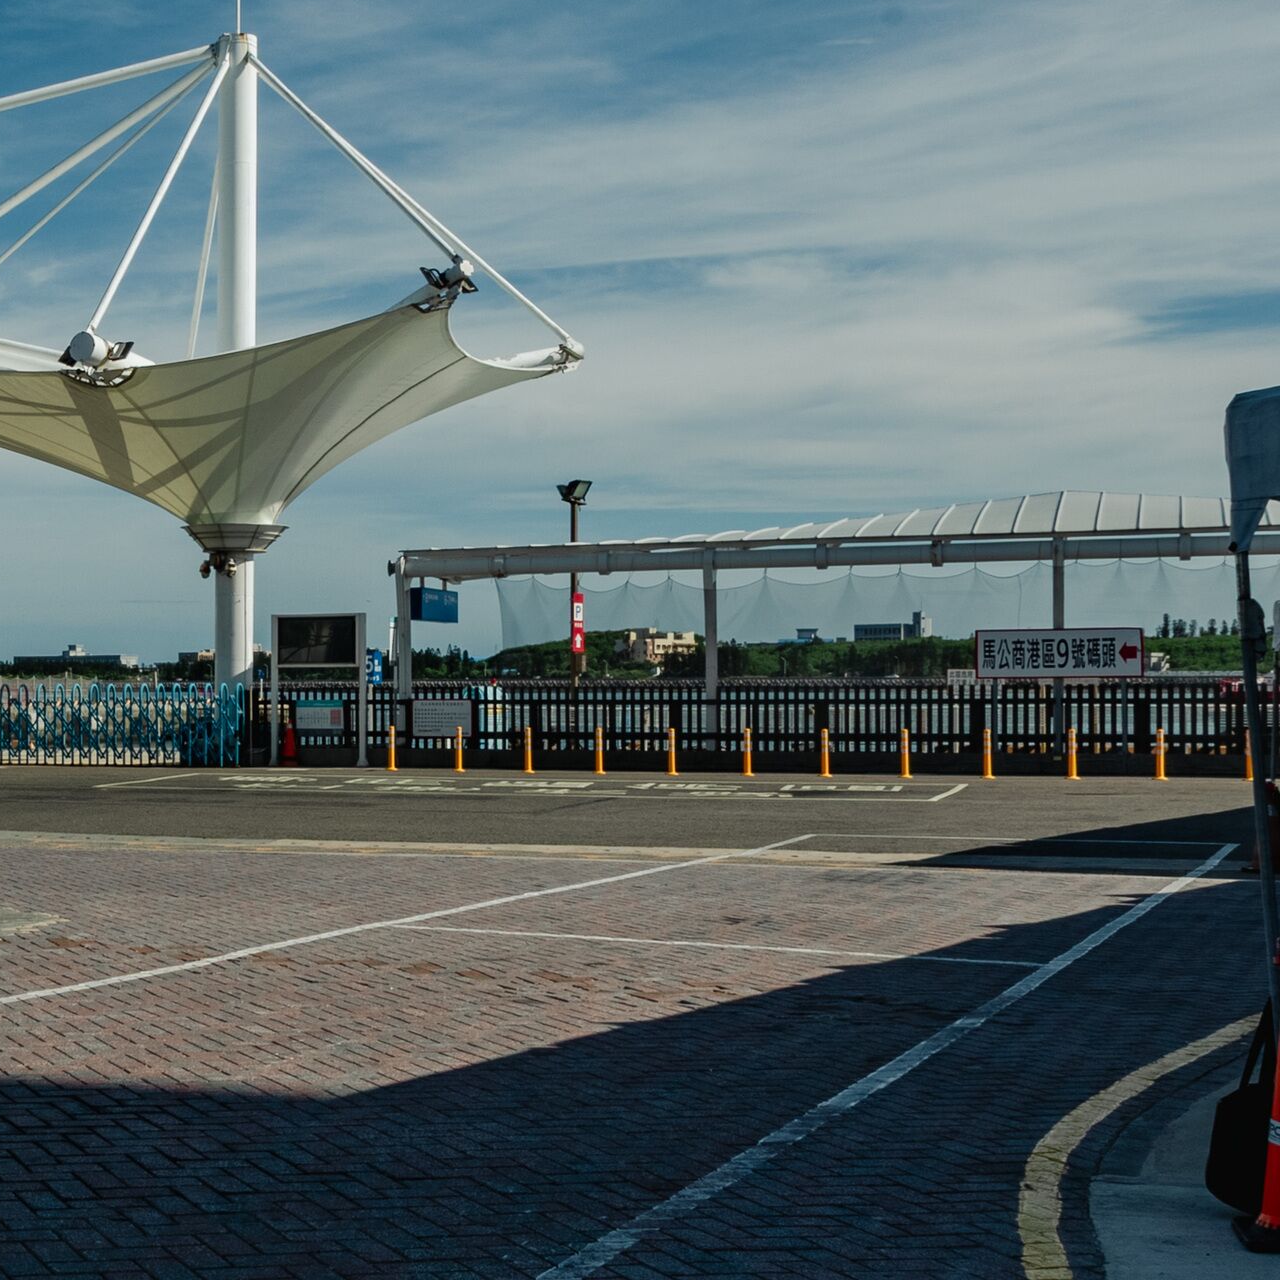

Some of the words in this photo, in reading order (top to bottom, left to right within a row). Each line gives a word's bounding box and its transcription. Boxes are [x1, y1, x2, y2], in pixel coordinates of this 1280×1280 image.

[982, 637, 1117, 670] 馬公商港區9號碼頭
